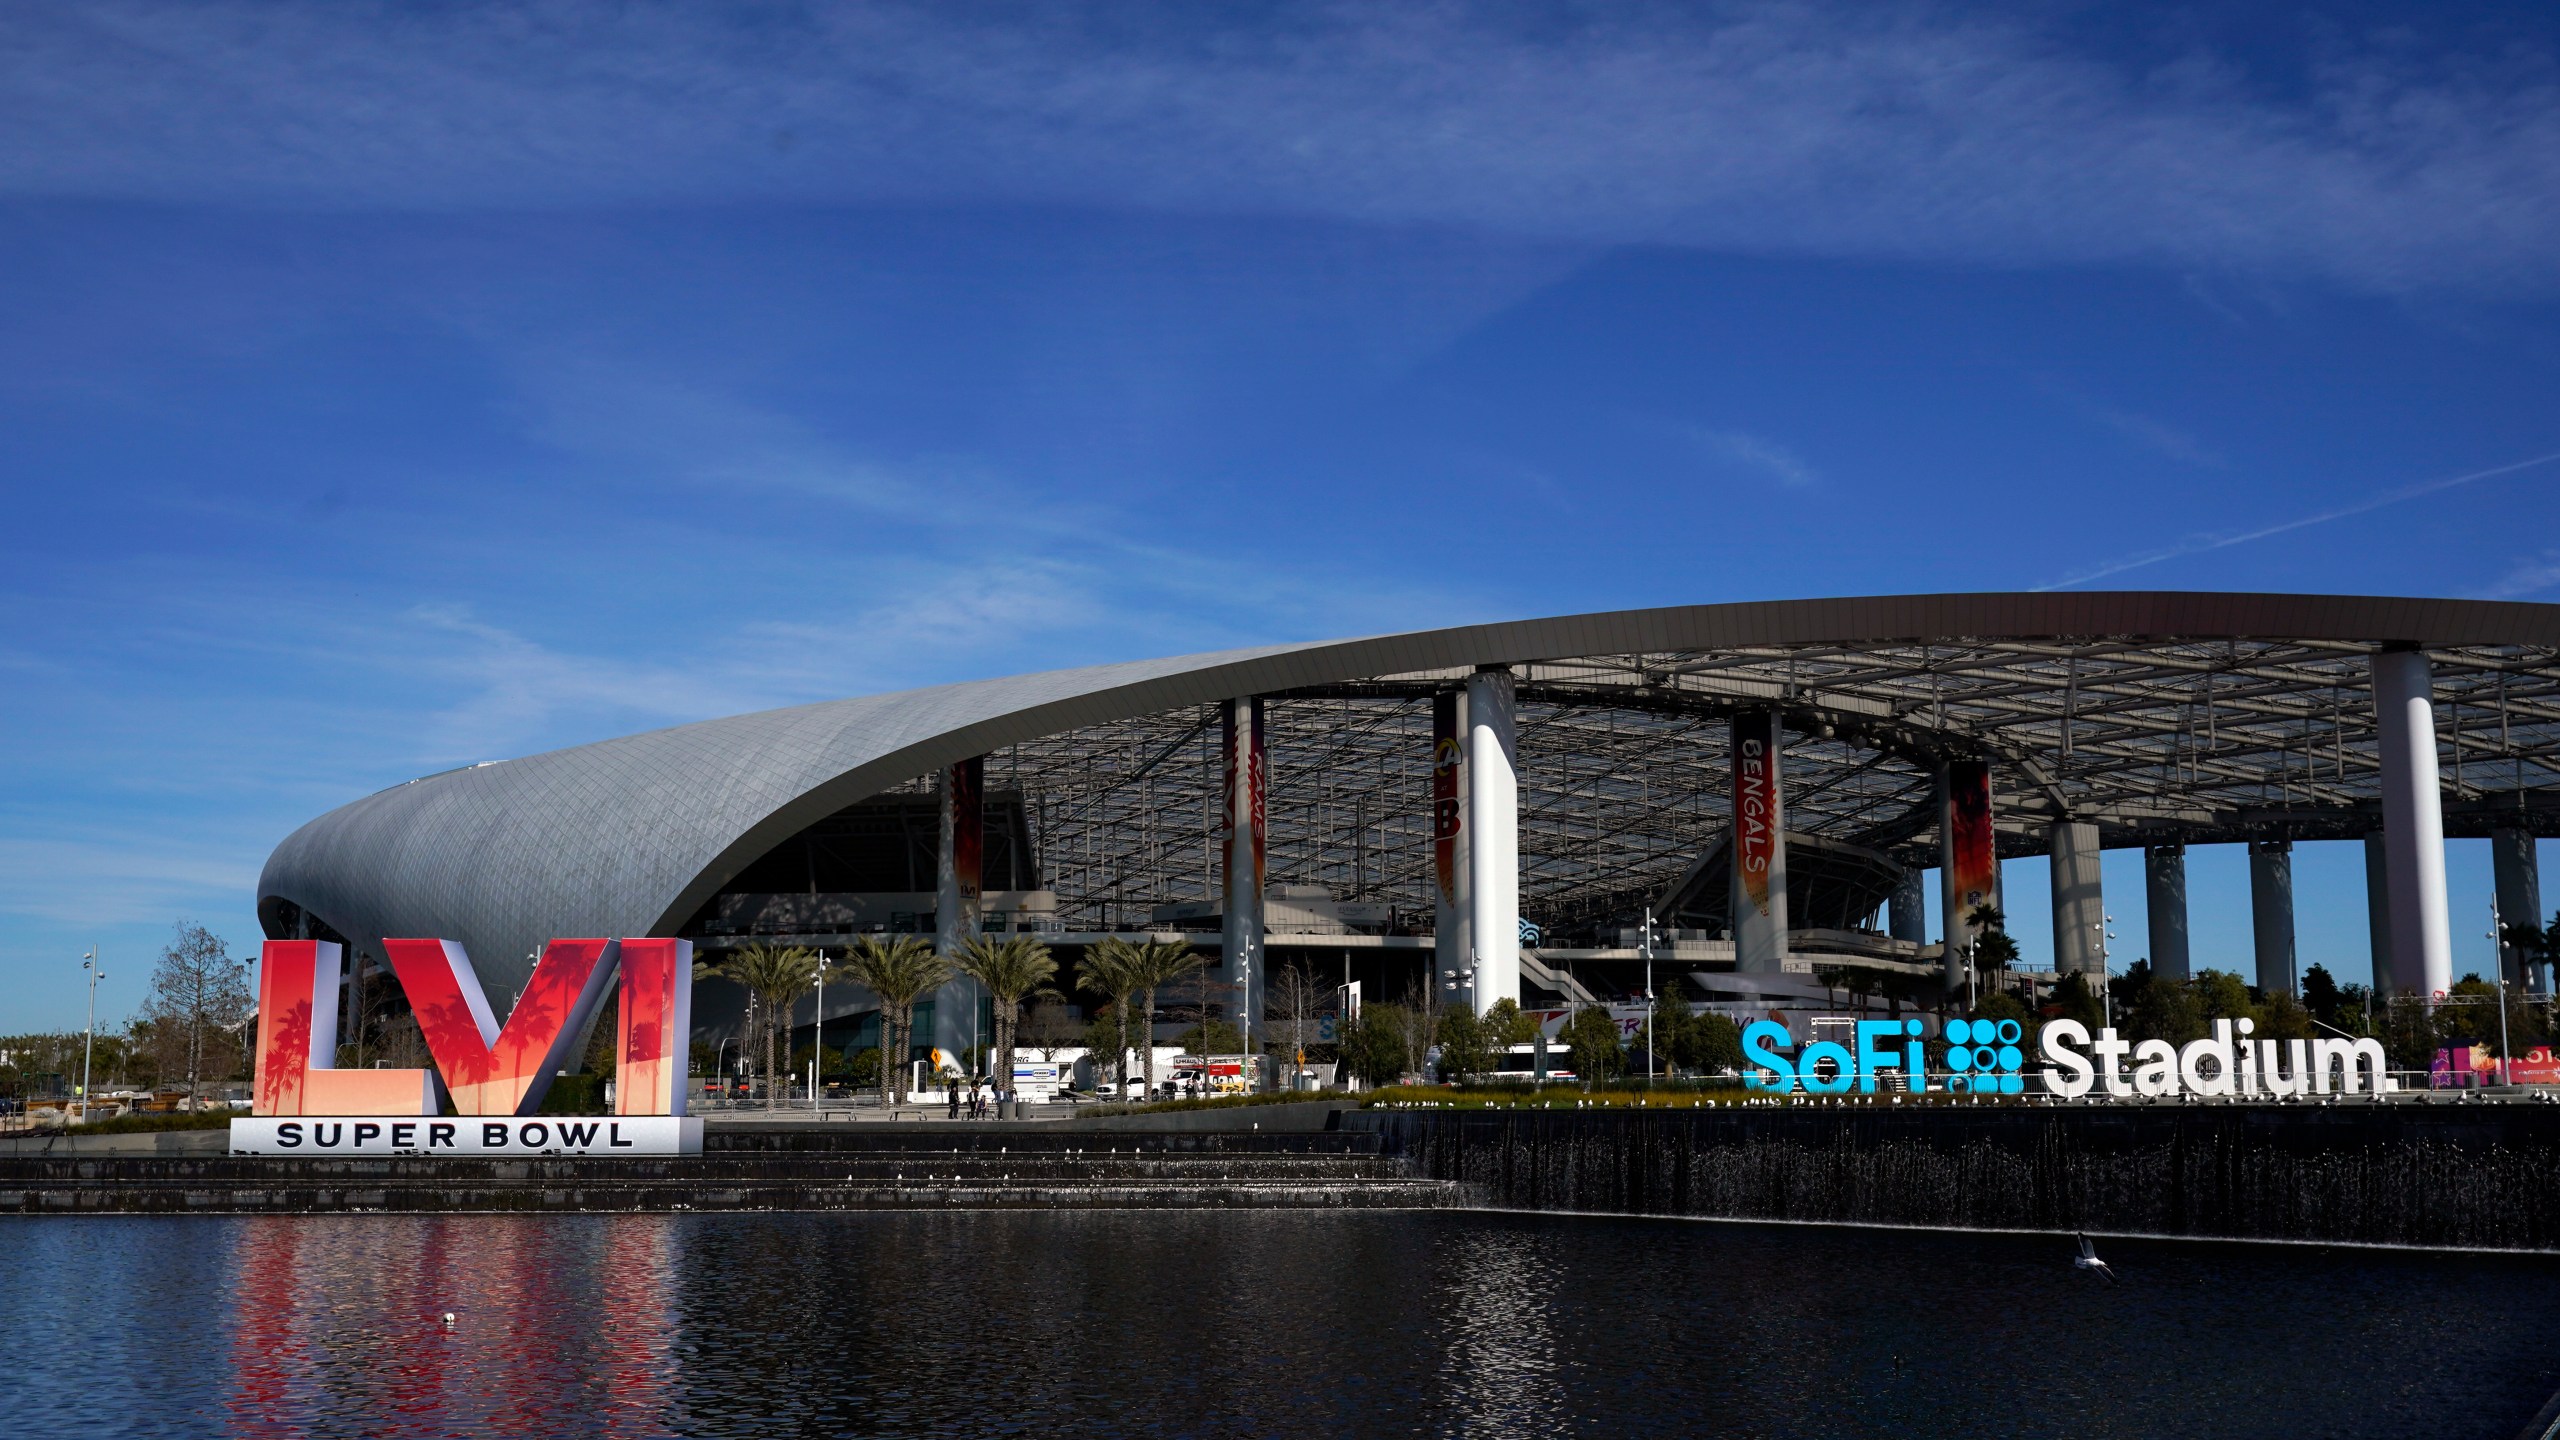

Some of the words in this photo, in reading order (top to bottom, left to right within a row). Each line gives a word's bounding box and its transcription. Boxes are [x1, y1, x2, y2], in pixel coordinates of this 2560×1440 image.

[1254, 751, 1264, 840] RAMS
[1741, 738, 1766, 873] BENGALS
[253, 937, 692, 1117] LVI
[1740, 1018, 1926, 1095] SoFi
[2037, 1018, 2387, 1098] Stadium
[275, 1122, 457, 1149] SUPER
[480, 1122, 635, 1149] BOWL
